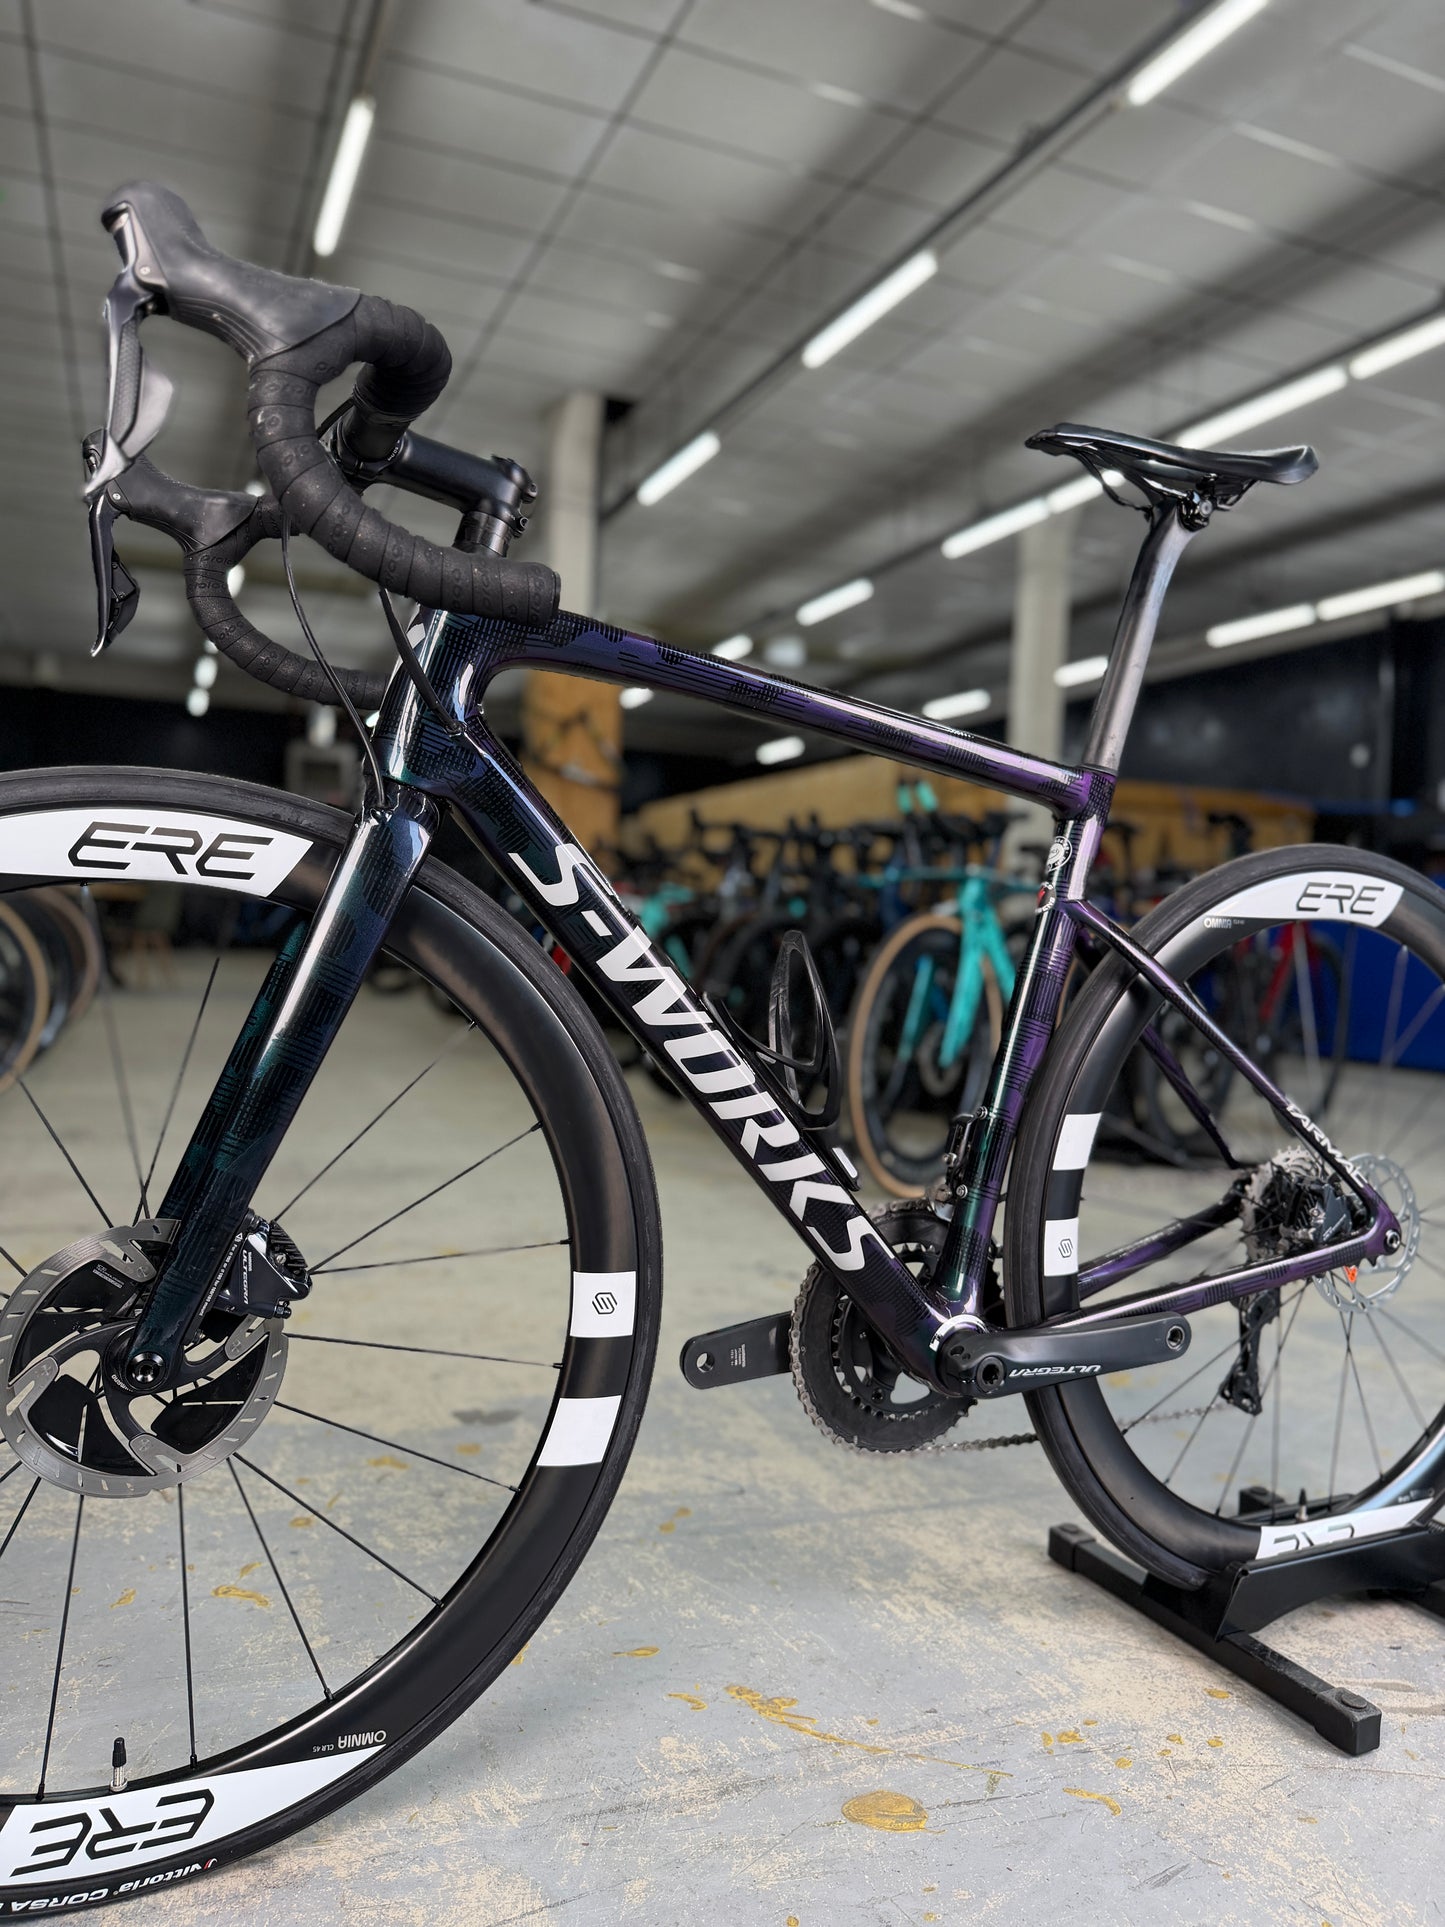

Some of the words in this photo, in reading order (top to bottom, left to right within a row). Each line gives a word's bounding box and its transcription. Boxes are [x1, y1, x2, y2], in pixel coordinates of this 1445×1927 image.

[67, 820, 274, 881] ERE
[1295, 881, 1386, 916] ERE
[507, 842, 897, 1272] S-WORKS
[1008, 1364, 1101, 1377] ULTEGRA
[337, 1730, 386, 1749] OMNIA
[10, 1787, 214, 1877] ERE
[10, 1888, 109, 1912] CORSA
